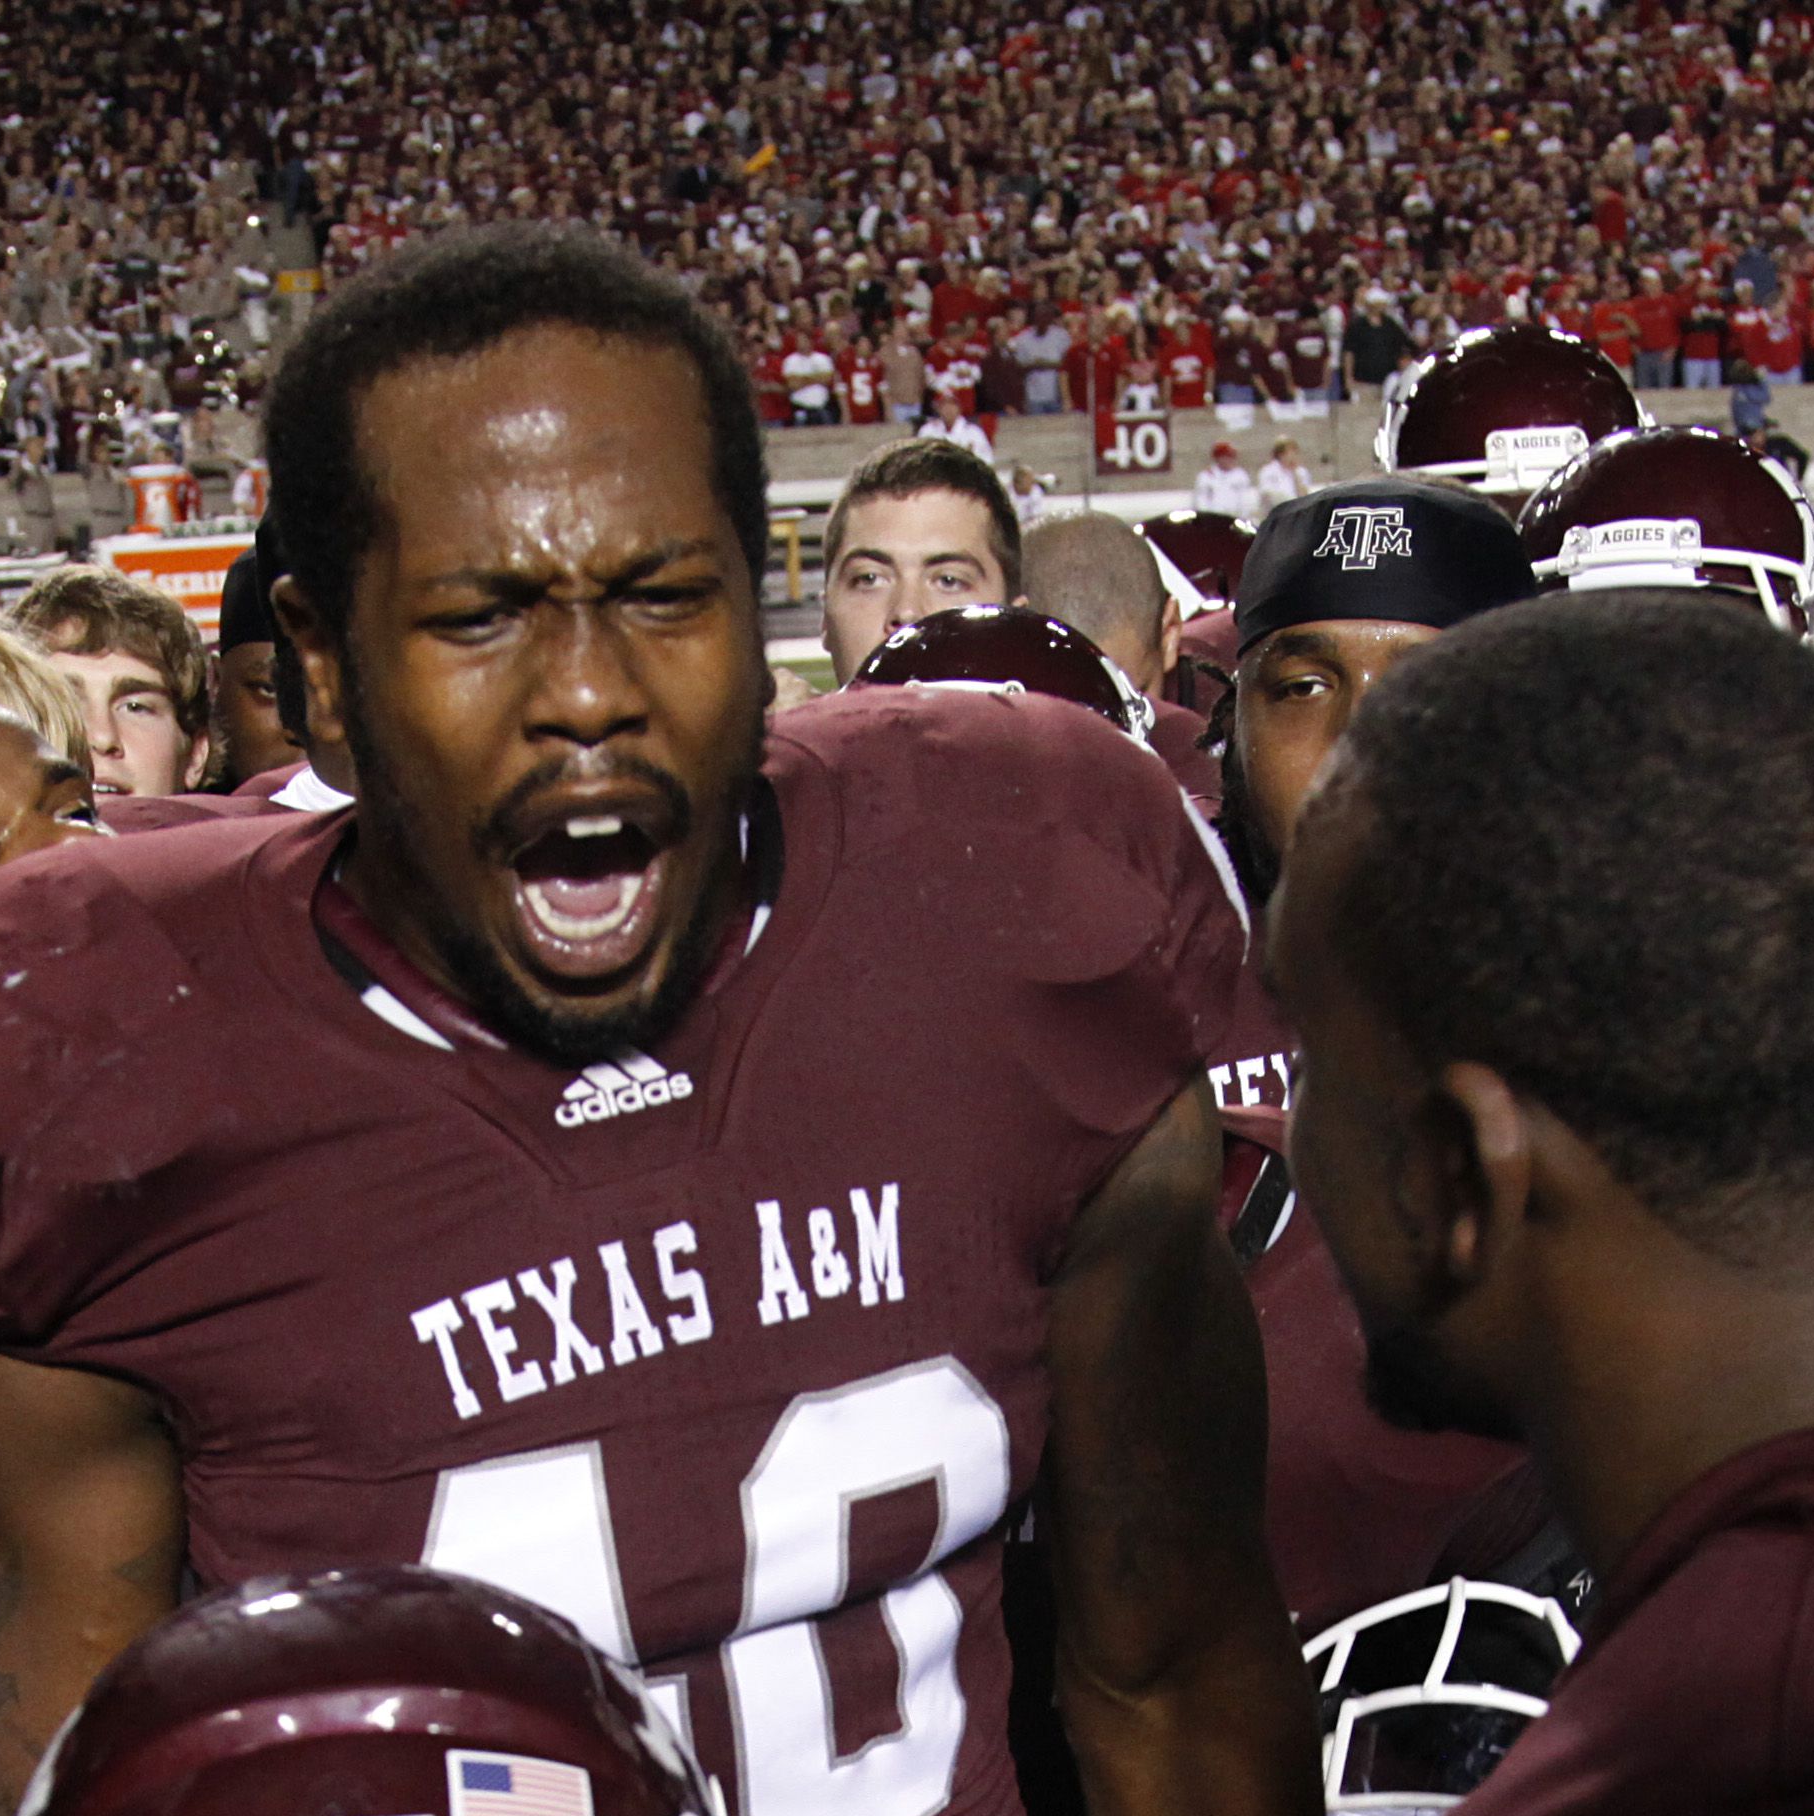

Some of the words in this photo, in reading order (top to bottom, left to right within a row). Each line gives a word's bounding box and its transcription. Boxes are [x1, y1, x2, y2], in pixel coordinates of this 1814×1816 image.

[1513, 435, 1561, 451] AGGIES
[1599, 527, 1665, 546] AGGIES
[555, 1071, 694, 1128] adidas
[411, 1220, 715, 1420] TEXAS
[756, 1183, 906, 1326] A&M
